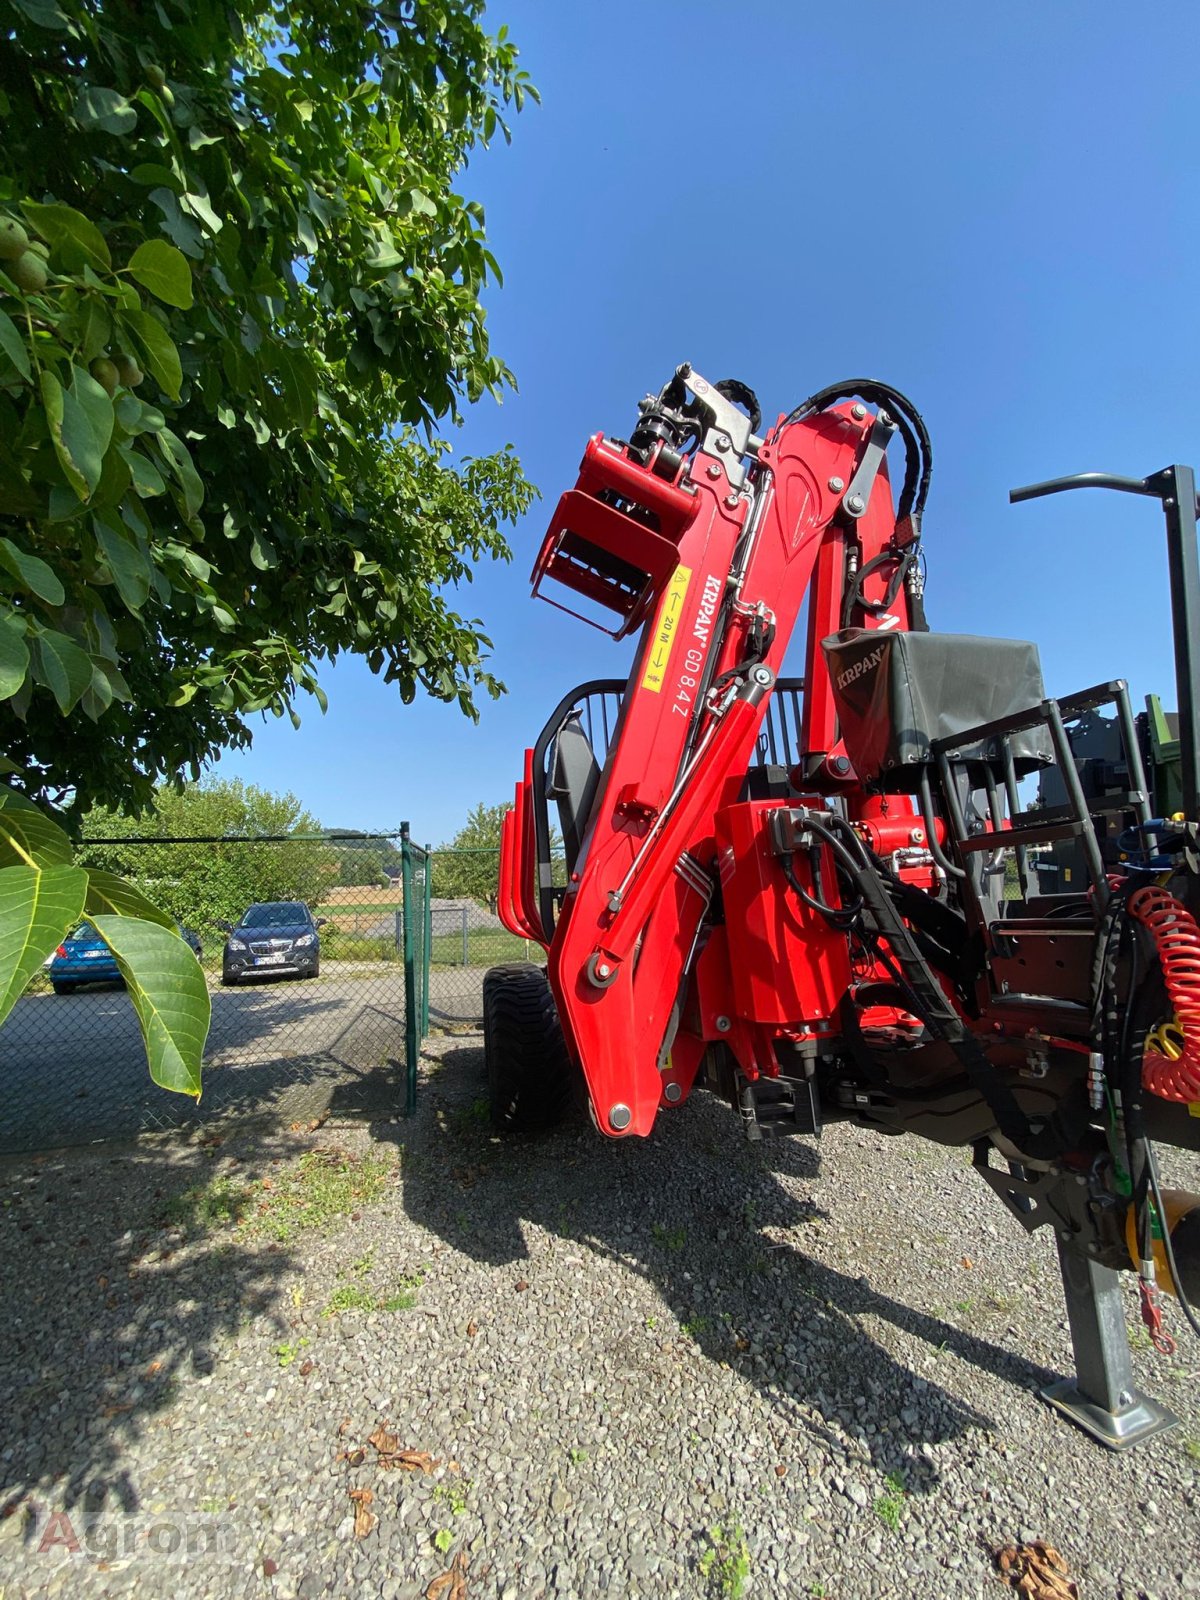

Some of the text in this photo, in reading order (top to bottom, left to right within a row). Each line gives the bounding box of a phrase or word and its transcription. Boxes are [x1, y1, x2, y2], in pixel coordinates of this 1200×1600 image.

[659, 616, 674, 644] 20 M
[684, 649, 703, 673] GD
[676, 675, 696, 702] 8,4
[672, 703, 689, 717] Z
